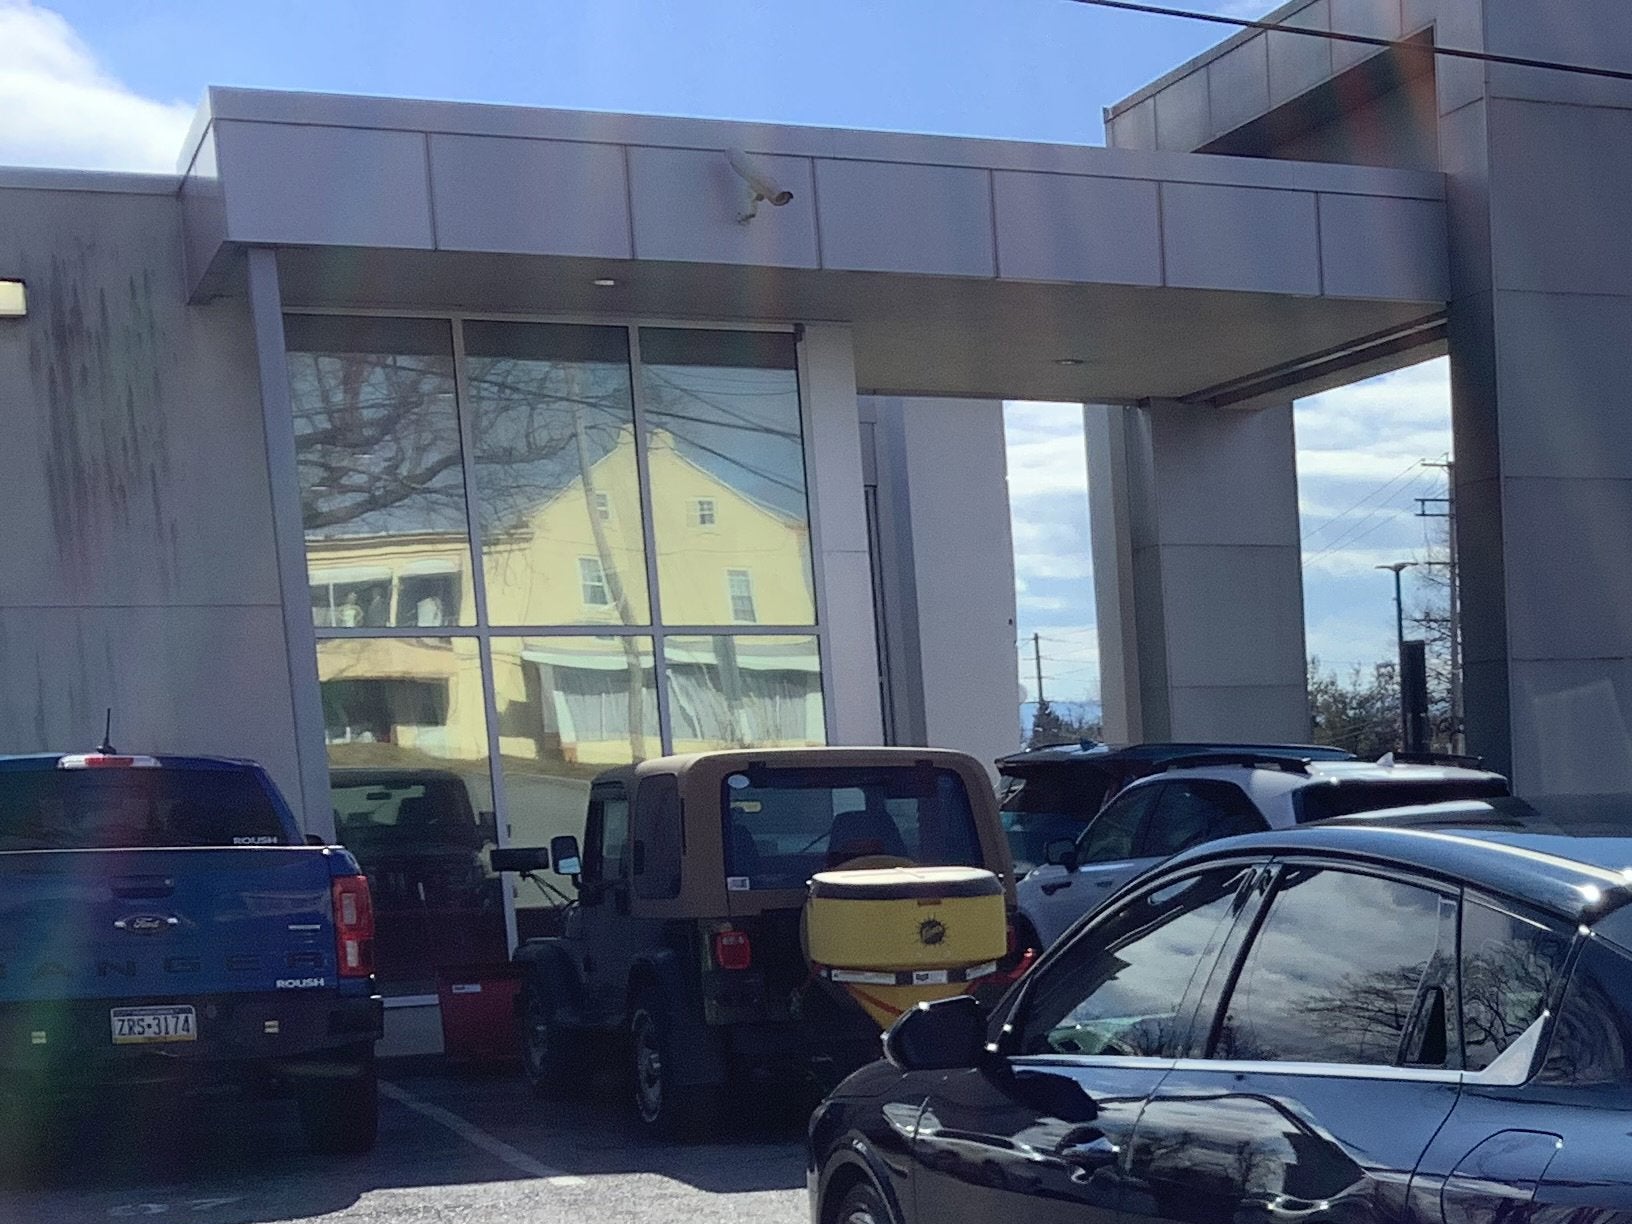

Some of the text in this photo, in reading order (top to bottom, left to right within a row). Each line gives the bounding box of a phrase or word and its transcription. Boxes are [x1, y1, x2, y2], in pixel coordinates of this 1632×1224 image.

[233, 836, 278, 845] ROUSH
[0, 951, 325, 979] ANGER
[276, 977, 325, 989] ROUSH
